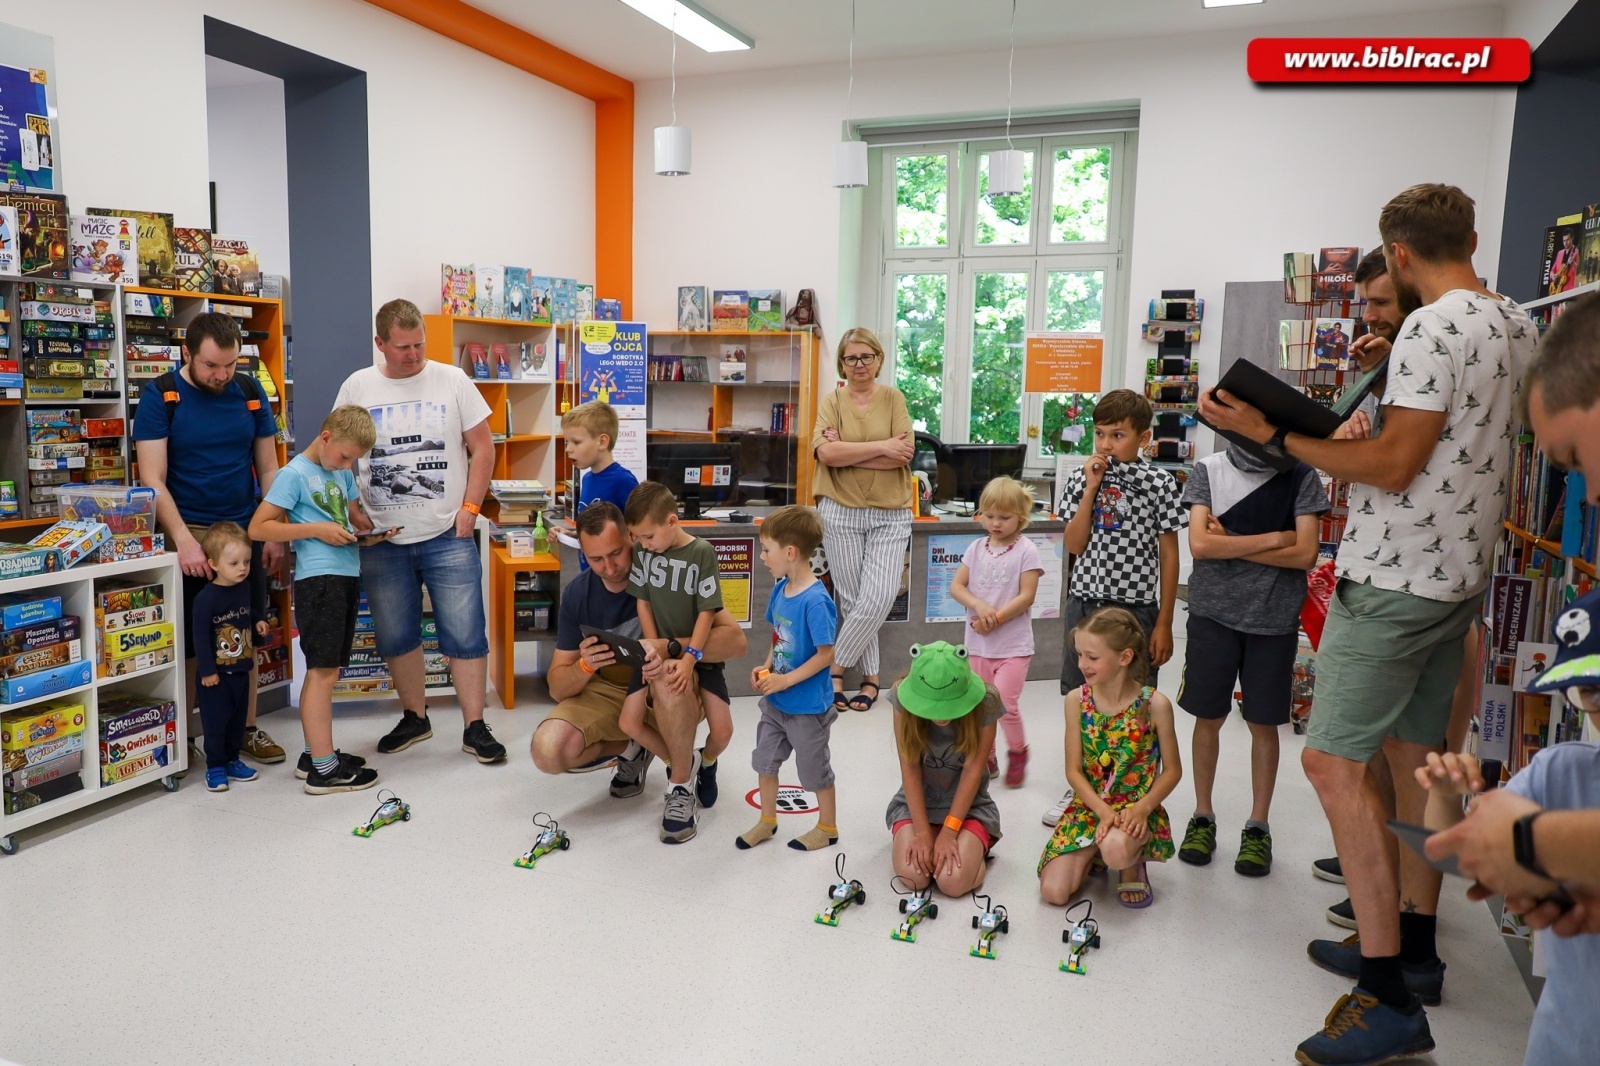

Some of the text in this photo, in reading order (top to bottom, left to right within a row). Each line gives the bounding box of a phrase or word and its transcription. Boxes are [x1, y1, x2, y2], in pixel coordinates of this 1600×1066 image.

[81, 224, 116, 236] MAZE
[174, 254, 195, 266] ZUL
[1543, 231, 1556, 286] HARRY STYLES
[1319, 273, 1353, 283] MIŁOŚĆ
[134, 299, 143, 307] DC
[50, 306, 82, 318] ORBIS
[615, 331, 641, 341] KLUB
[613, 342, 643, 351] OJCA
[393, 436, 419, 444] LESS
[418, 462, 446, 470] POWER
[932, 547, 945, 555] DNI
[717, 553, 748, 561] WAL GIER
[0, 556, 41, 570] OSADNICY
[718, 562, 750, 570] OWYCH
[212, 609, 240, 624] Cheeky
[1507, 584, 1525, 651] INSCENIZACJE
[1483, 700, 1495, 742] HISTORIA
[1495, 704, 1507, 738] POLSKI
